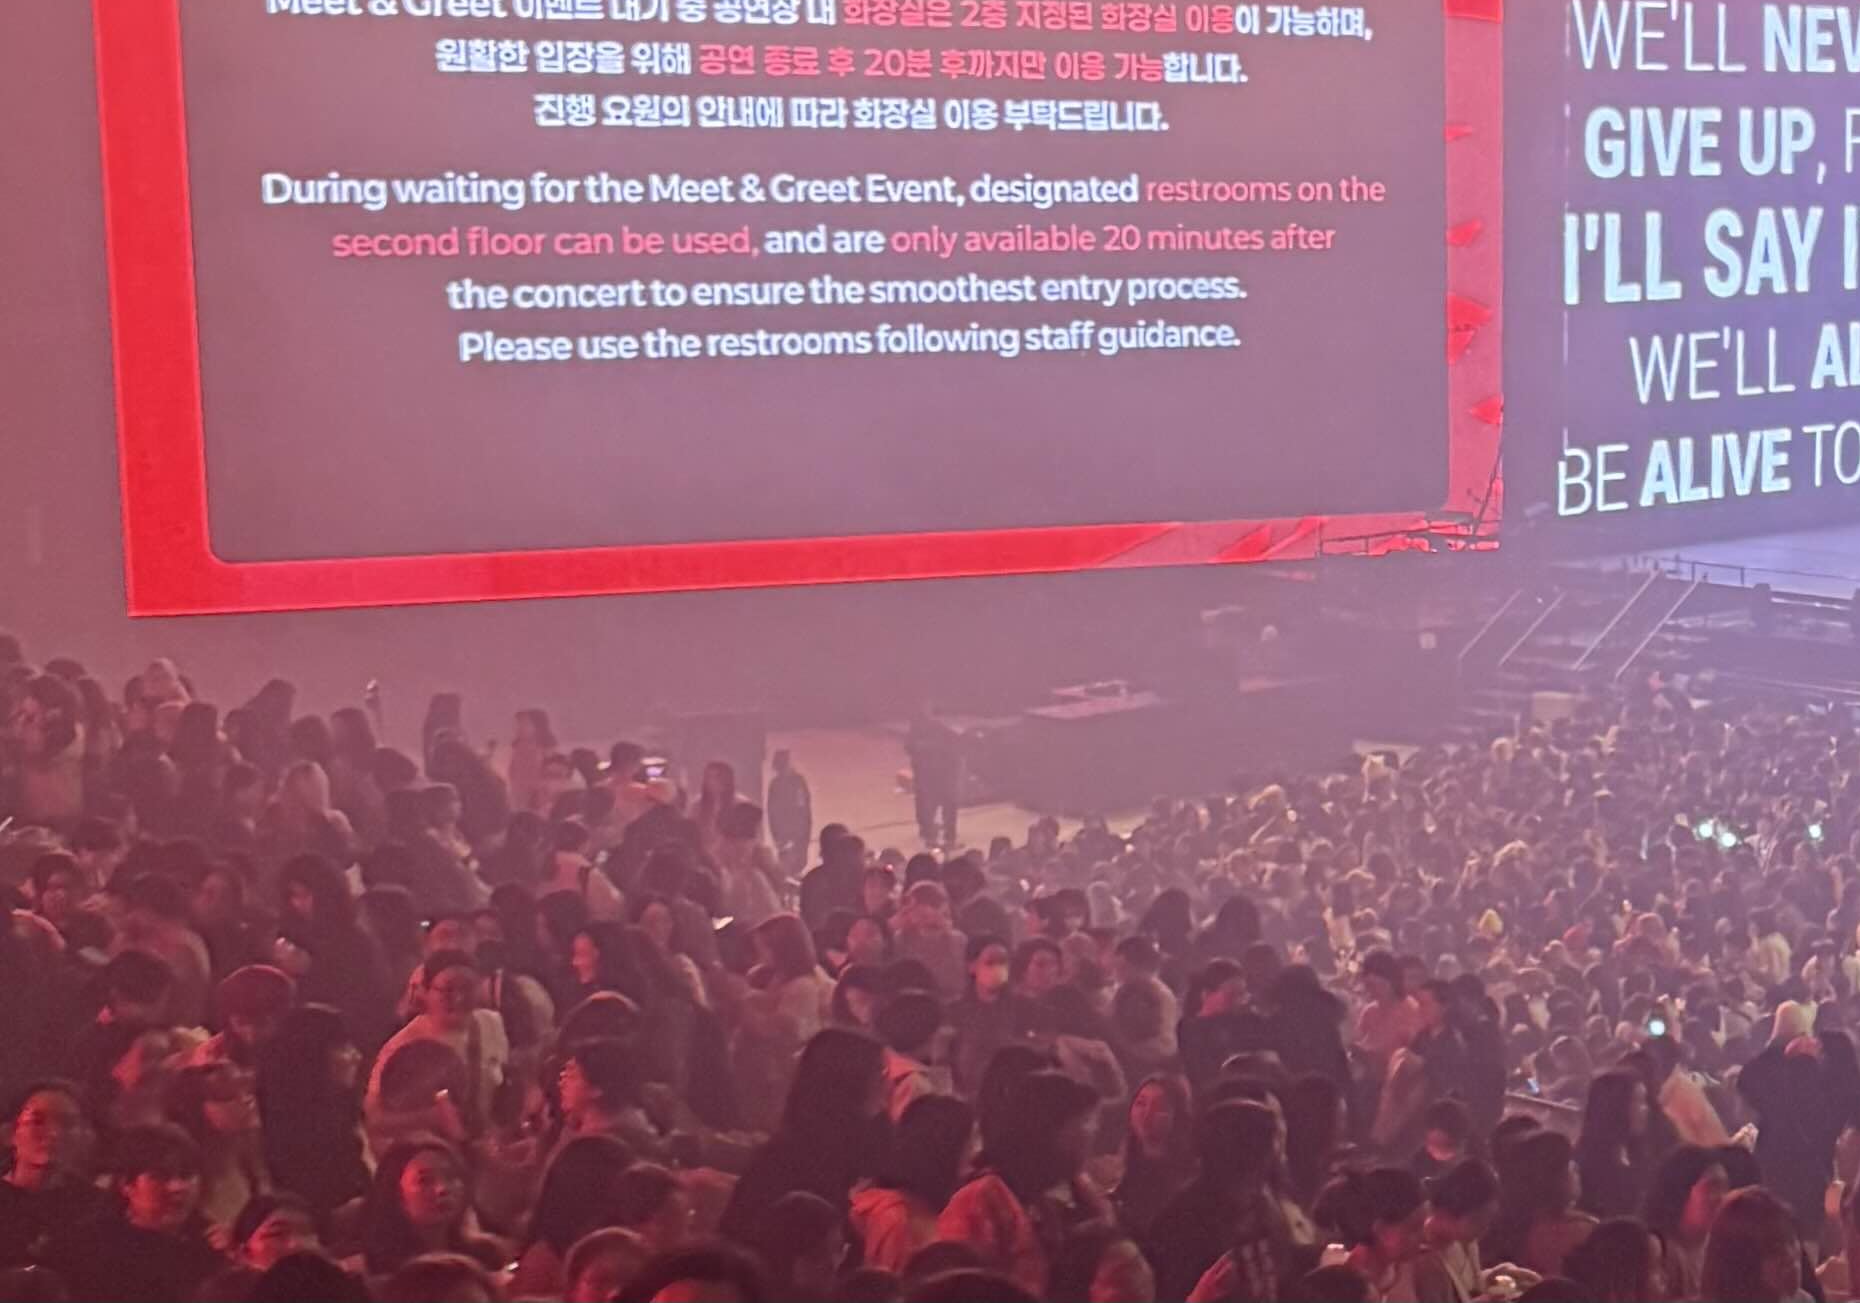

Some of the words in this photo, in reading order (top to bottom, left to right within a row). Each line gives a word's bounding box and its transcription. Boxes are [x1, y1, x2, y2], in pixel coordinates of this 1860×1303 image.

[960, 0, 1009, 29] 2층
[1016, 0, 1094, 31] 지정된
[1101, 2, 1177, 33] 화장실
[1265, 6, 1374, 41] 가능하며,
[535, 42, 625, 75] 입장을
[631, 43, 691, 75] 위해
[699, 46, 755, 75] 공연
[764, 46, 819, 78] 종료
[827, 47, 854, 77] 후
[864, 48, 933, 79] 20분
[939, 50, 1046, 80] 후까지만
[1055, 52, 1105, 81] 이용
[533, 94, 596, 127] 진행
[602, 96, 689, 128] 요원의
[696, 97, 783, 129] 안내에
[791, 98, 847, 130] 따라
[853, 98, 937, 130] 화장실
[943, 100, 998, 132] 이용
[1004, 101, 1170, 133] 부탁드립니다.
[1585, 107, 1721, 177] GIVE
[1739, 107, 1825, 184] UP,
[261, 173, 387, 212] During
[393, 173, 525, 212] waiting
[529, 172, 583, 204] for
[585, 174, 644, 205] the
[648, 175, 734, 204] Meet
[739, 175, 766, 204] &
[770, 175, 861, 203] Greet
[865, 174, 967, 207] Event,
[969, 173, 1138, 209] designated
[1145, 177, 1292, 204] restrooms
[1298, 178, 1334, 203] on
[1339, 176, 1386, 203] the
[332, 226, 459, 259] second
[465, 226, 544, 258] floor
[553, 231, 614, 257] can
[621, 226, 664, 256] be
[672, 226, 760, 259] used,
[764, 226, 827, 255] and
[833, 230, 885, 255] are
[891, 226, 958, 258] only
[965, 224, 1095, 253] available
[1102, 226, 1141, 252] 20
[1148, 224, 1265, 252] minutes
[1270, 223, 1336, 250] after
[1564, 212, 1682, 304] I'LL
[1704, 207, 1822, 297] SAY
[446, 278, 508, 311] the
[512, 279, 647, 309] concert
[652, 281, 687, 307] to
[692, 279, 805, 304] ensure
[810, 274, 865, 305] the
[870, 274, 1037, 304] smoothest
[1041, 276, 1123, 307] entry
[1127, 274, 1248, 306] process.
[459, 330, 571, 364] Please
[578, 335, 639, 361] use
[642, 329, 702, 359] the
[706, 331, 873, 356] restrooms
[876, 322, 1021, 358] following
[1025, 320, 1095, 350] staff
[1098, 320, 1241, 357] guidance.
[1630, 325, 1795, 404] WE'LL
[1558, 446, 1628, 515] BE
[1639, 429, 1791, 506] ALIVE
